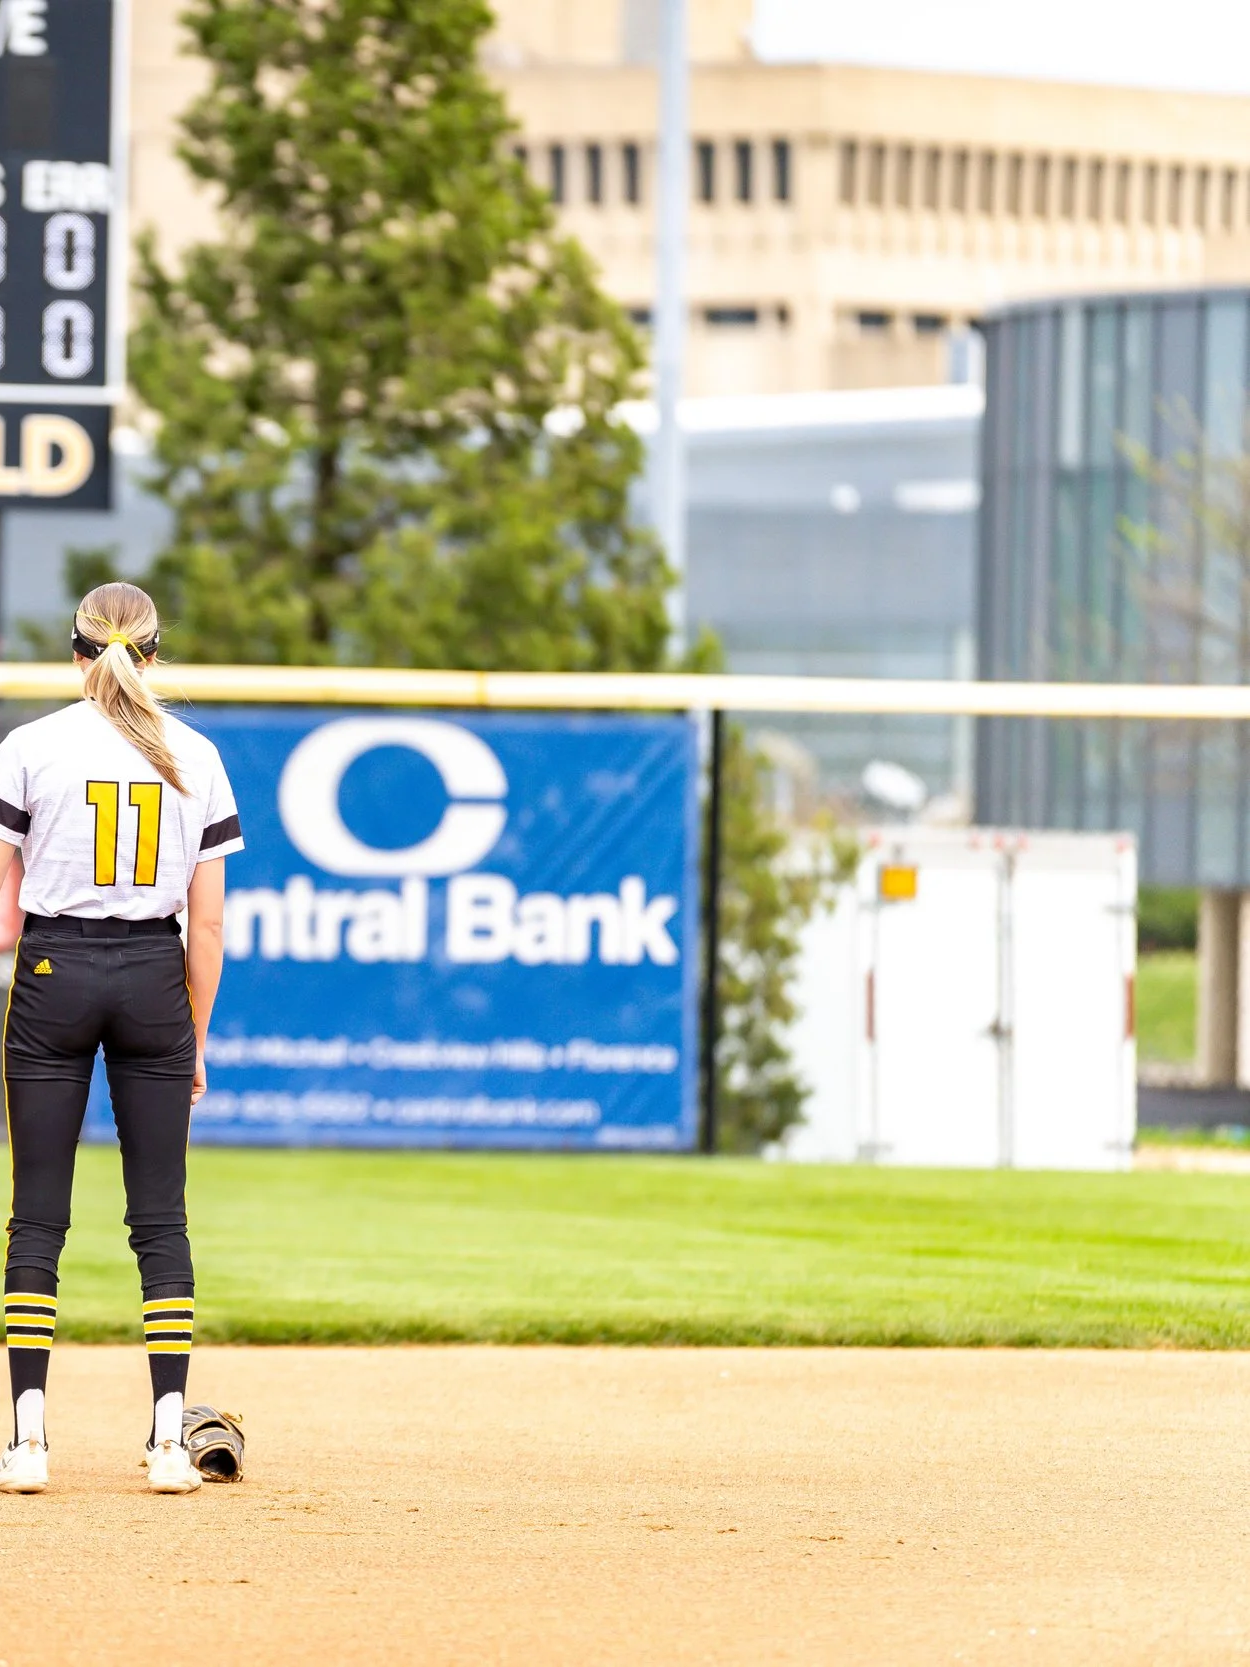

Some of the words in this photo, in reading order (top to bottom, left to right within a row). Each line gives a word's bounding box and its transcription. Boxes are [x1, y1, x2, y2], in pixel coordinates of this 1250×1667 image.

[44, 212, 95, 291] 0
[42, 300, 94, 379] 0
[85, 780, 163, 887] 11
[223, 874, 429, 962] ntral
[446, 872, 679, 965] Bank
